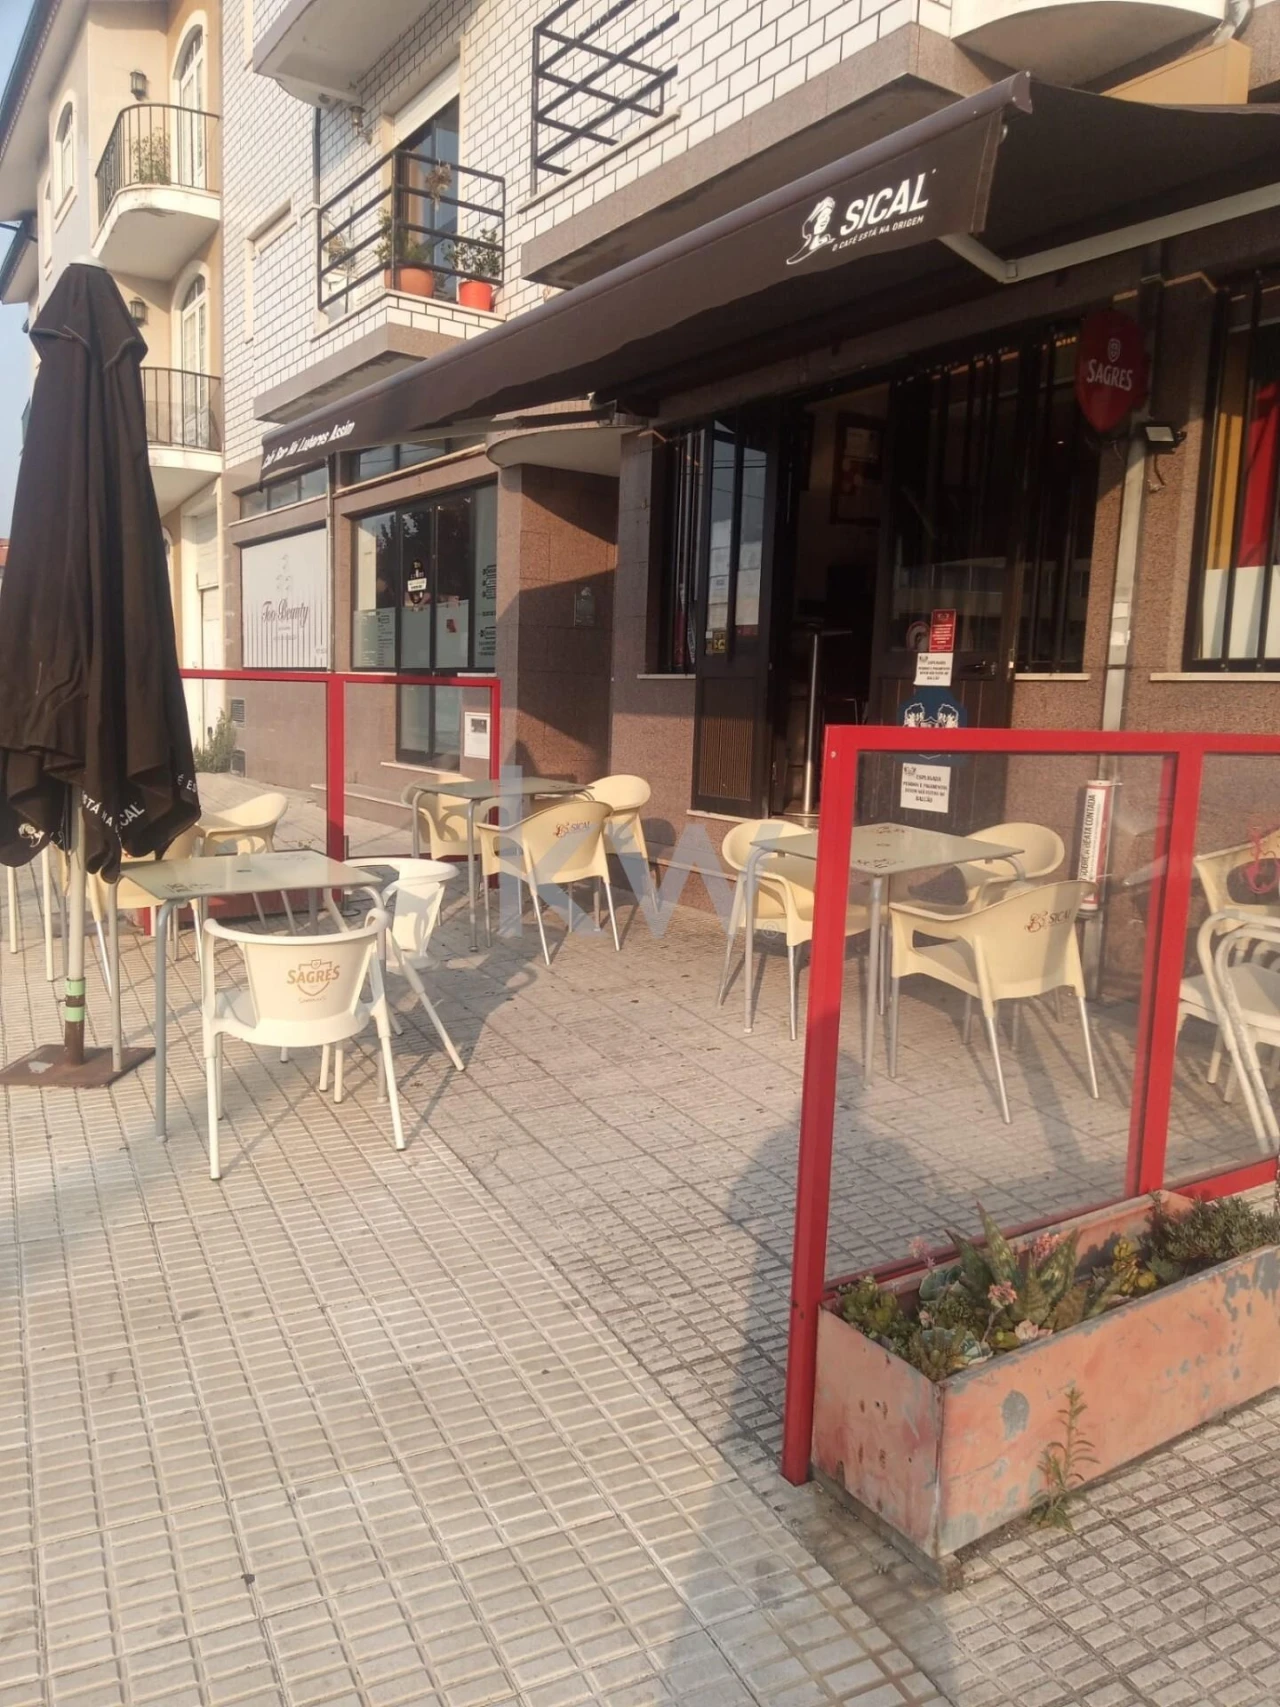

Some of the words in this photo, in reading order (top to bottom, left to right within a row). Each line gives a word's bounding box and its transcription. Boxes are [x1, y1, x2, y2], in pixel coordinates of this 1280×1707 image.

[839, 172, 929, 236] SICAL
[838, 234, 858, 249] CAFÉ
[857, 226, 878, 242] ESTÁ
[879, 224, 890, 235] NA
[891, 215, 924, 232] ORIGEM
[1087, 359, 1133, 391] SAGRES
[1087, 794, 1096, 827] CONTADA
[287, 965, 340, 984] SAGRES
